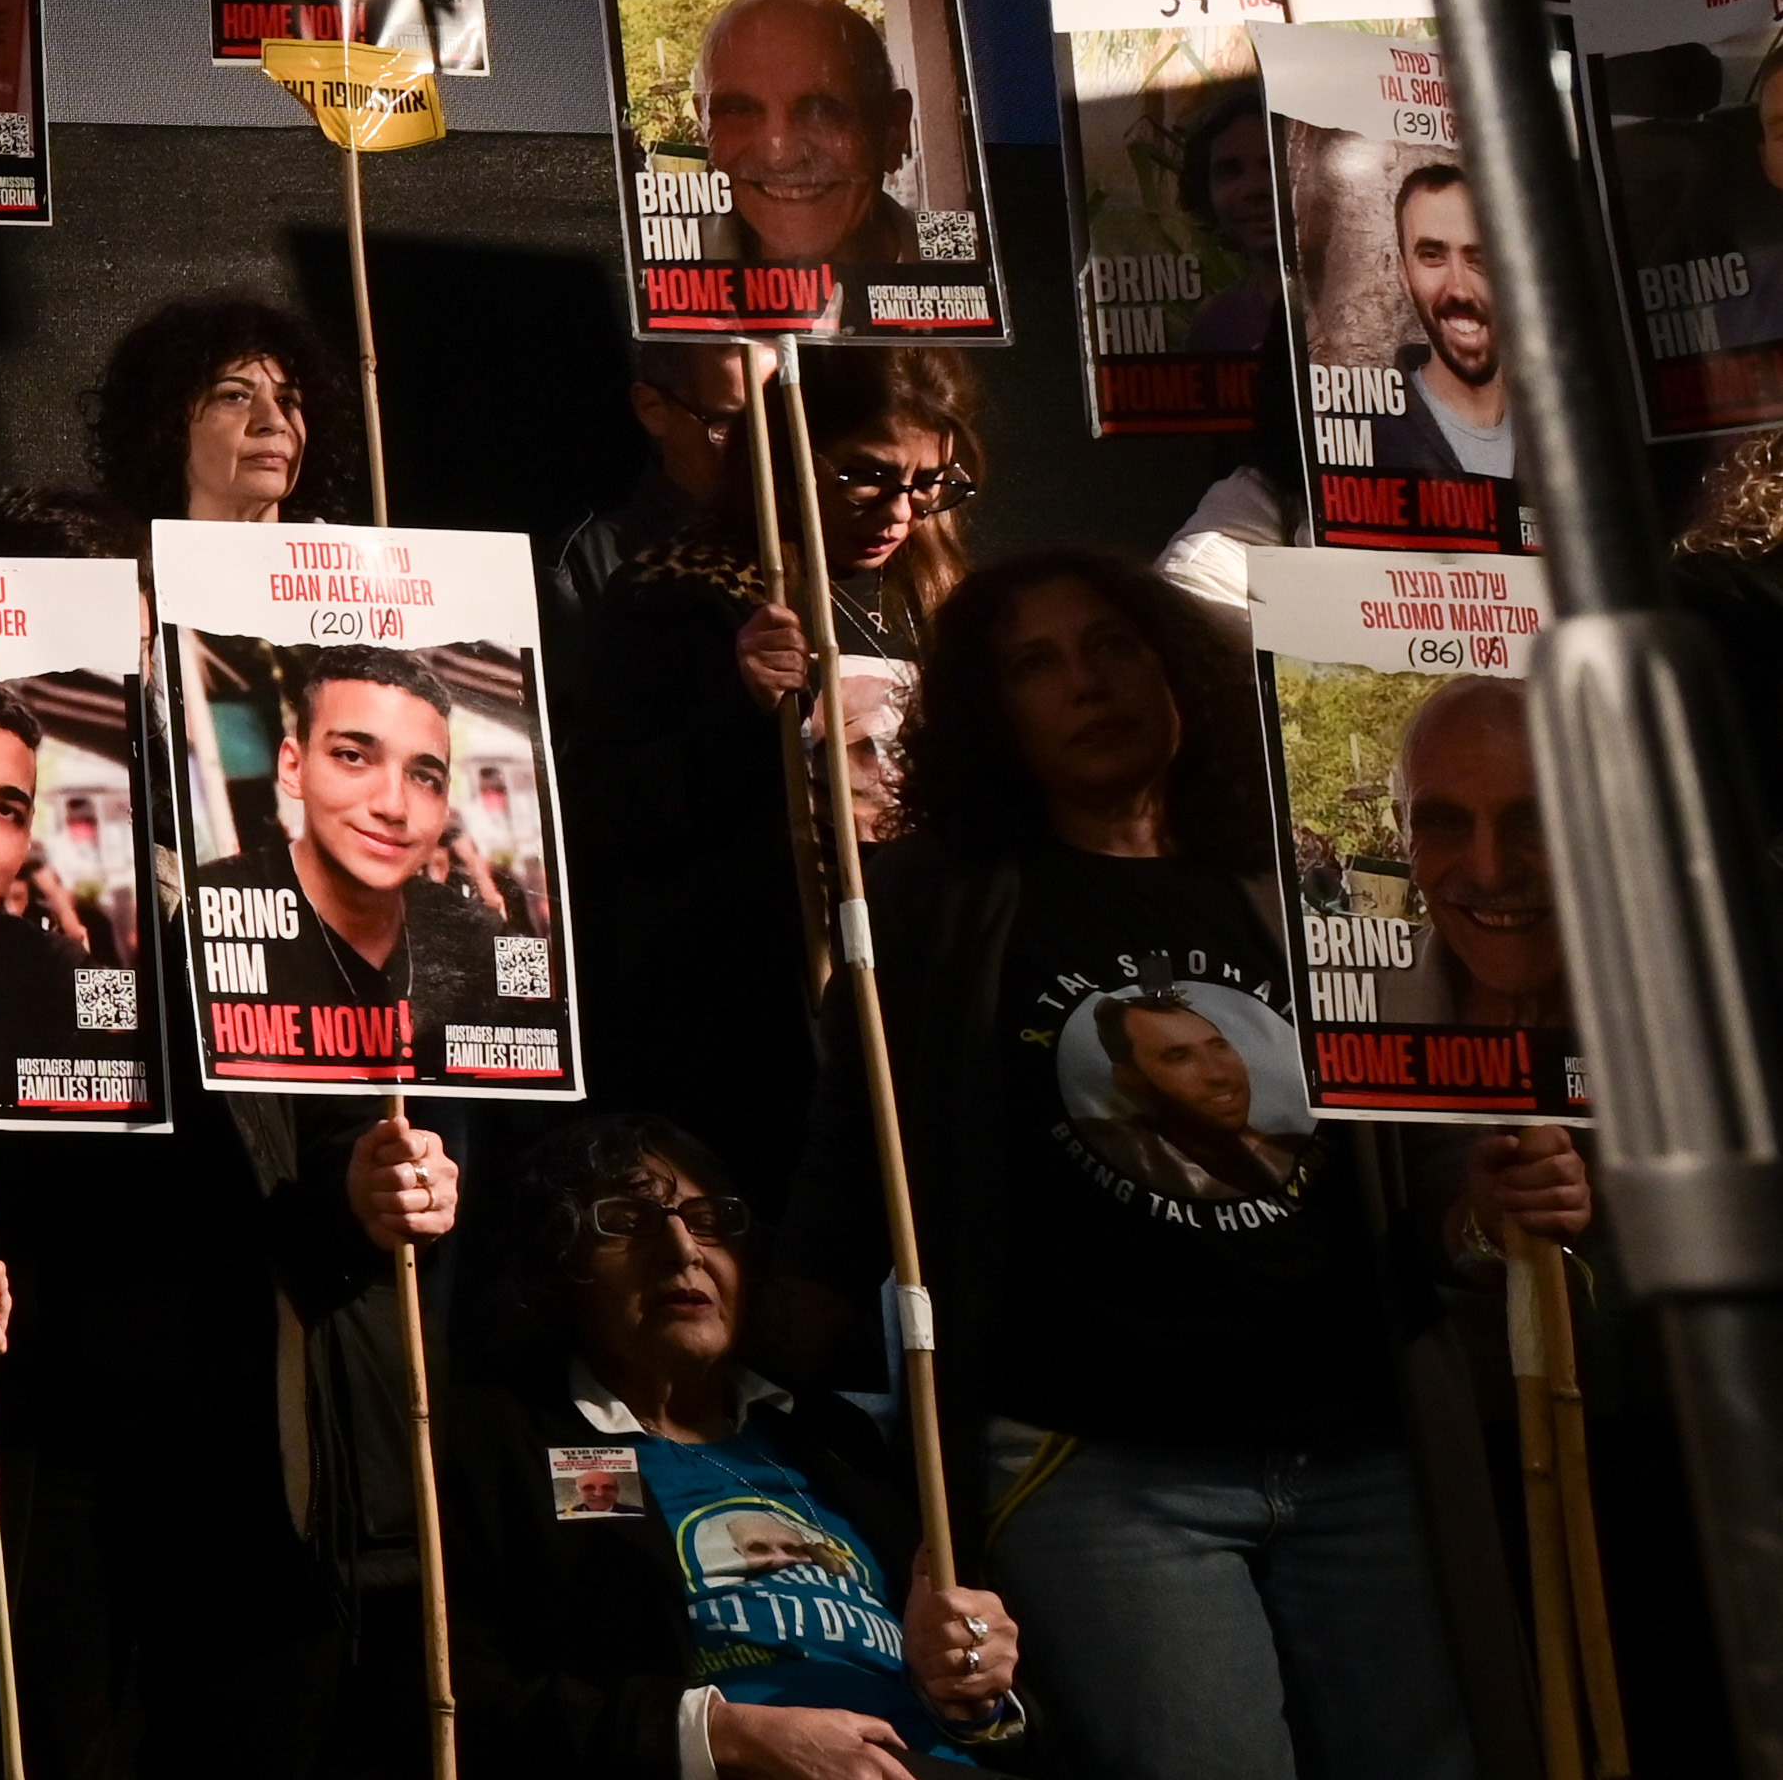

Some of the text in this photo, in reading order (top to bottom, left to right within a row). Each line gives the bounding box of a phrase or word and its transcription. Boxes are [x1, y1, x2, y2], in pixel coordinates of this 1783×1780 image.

[1378, 73, 1408, 102] TAL
[1393, 109, 1437, 138] (39)
[640, 217, 703, 261] HIM
[1315, 417, 1374, 467] HIM
[270, 573, 434, 607] EDAN ALEXANDER
[1385, 569, 1508, 600] שלמה מנצור
[1360, 601, 1540, 634] SHLOMO MANTZUR
[17, 1057, 145, 1078] HOSTAGES AND MISSING
[446, 1042, 559, 1071] FAMILIES FORUM
[18, 1075, 147, 1103] FAMILIES FORUM
[1145, 1191, 1203, 1229] TAL
